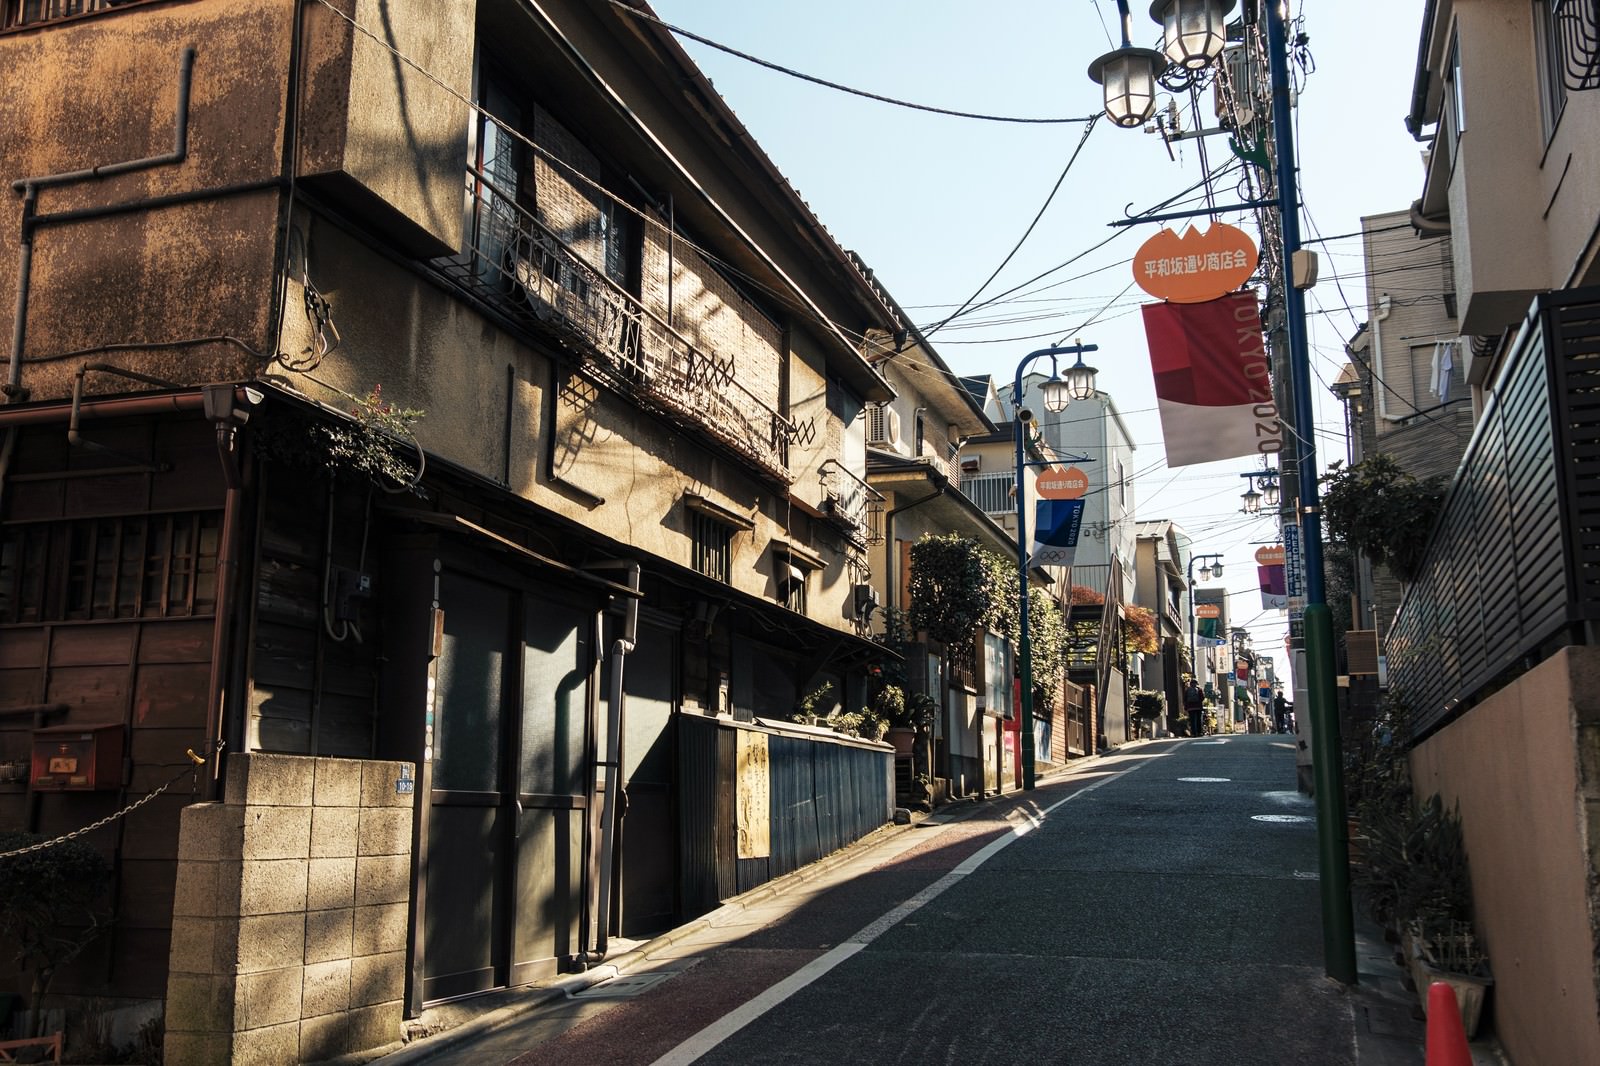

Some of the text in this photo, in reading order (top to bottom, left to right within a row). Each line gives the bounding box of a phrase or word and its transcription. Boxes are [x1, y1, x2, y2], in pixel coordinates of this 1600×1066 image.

[1144, 249, 1248, 279] 平和坂通り商店会
[1232, 292, 1284, 454] TOKYO 2020
[1071, 504, 1081, 528] TOKYO
